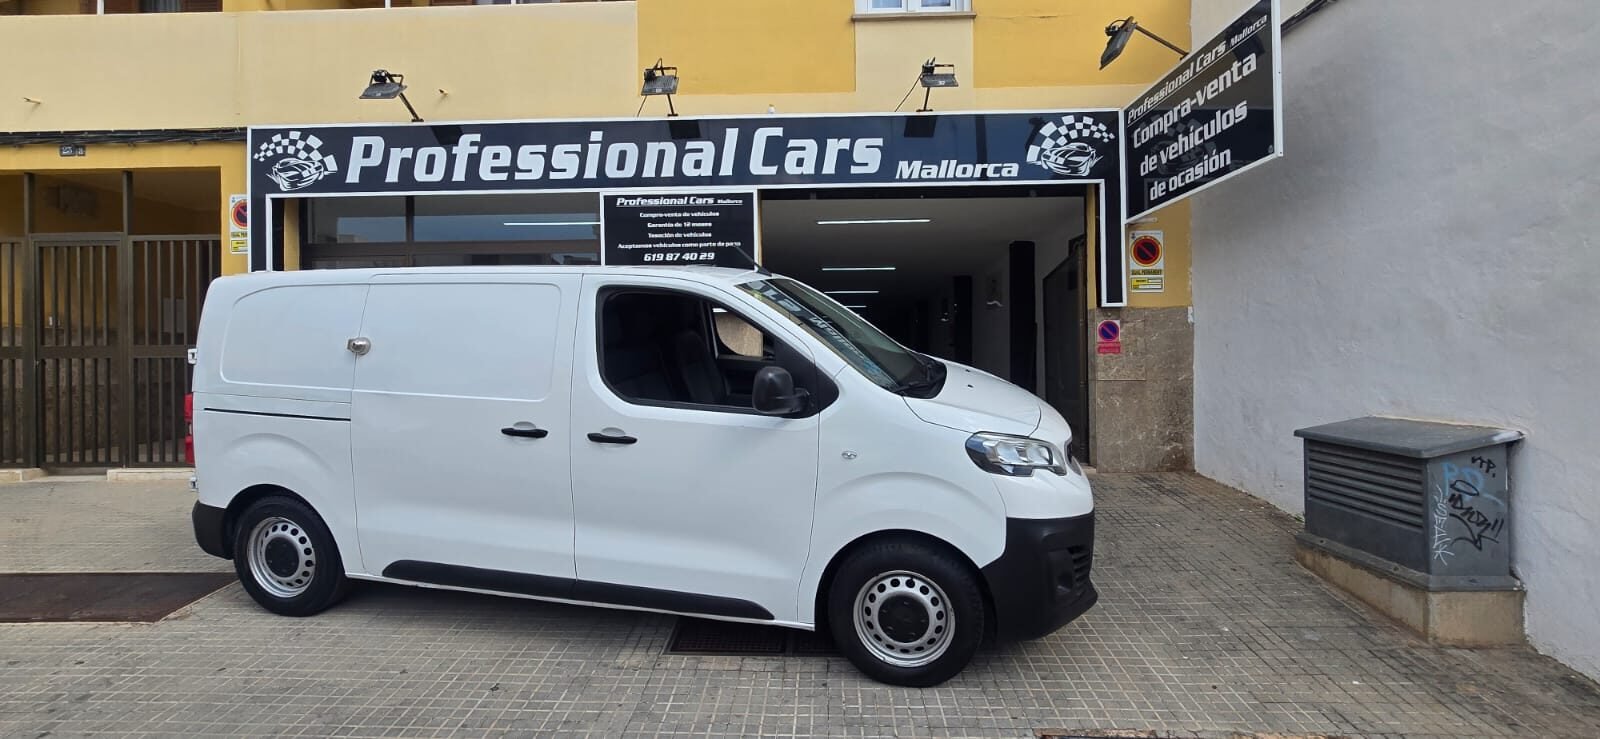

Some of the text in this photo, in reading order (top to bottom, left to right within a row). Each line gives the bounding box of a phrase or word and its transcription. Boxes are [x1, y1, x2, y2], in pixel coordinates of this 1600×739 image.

[1127, 14, 1267, 124] Professional Cars Mallorca
[1133, 52, 1257, 149] Compra-venta
[345, 127, 1019, 183] Professional Cars Mallorca
[1140, 100, 1248, 177] de vehículos
[616, 197, 688, 206] Professional
[689, 196, 714, 205] Cars
[1150, 148, 1231, 201] de ocasión
[643, 252, 715, 262] 619 87 40 29
